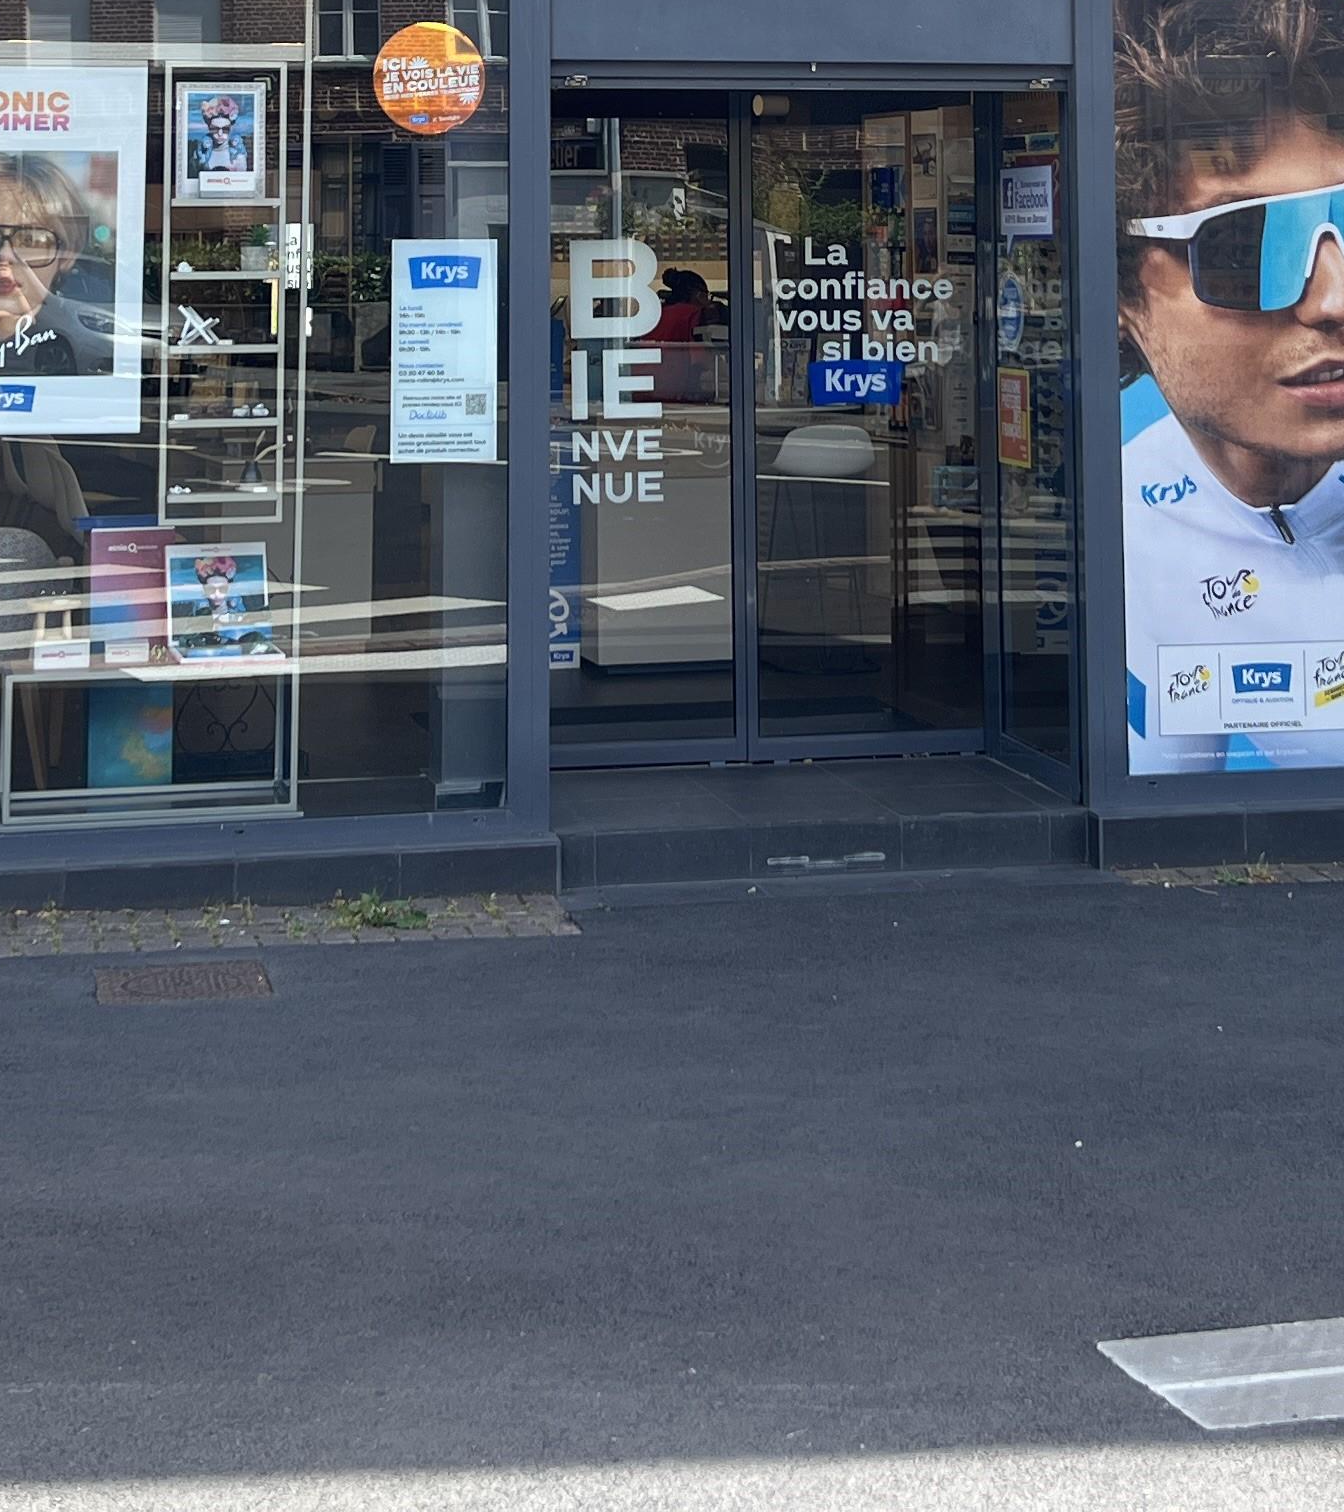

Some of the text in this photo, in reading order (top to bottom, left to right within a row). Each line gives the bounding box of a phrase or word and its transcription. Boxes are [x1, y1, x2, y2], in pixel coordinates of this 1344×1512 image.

[383, 57, 406, 72] ICI
[383, 63, 480, 83] JE VOIS LA VIE
[383, 74, 479, 94] EN COULEUR
[804, 236, 849, 266] La
[420, 261, 469, 284] Krys
[775, 271, 954, 301] confiance
[776, 308, 915, 332] vous va
[821, 333, 939, 363] si bien
[824, 368, 888, 398] Krys
[572, 429, 664, 462] NVE
[694, 431, 729, 454] Kry
[572, 470, 665, 506] NUE
[1140, 473, 1197, 508] Krys
[1242, 668, 1282, 688] Krys
[1223, 721, 1269, 730] PARTENAIRE
